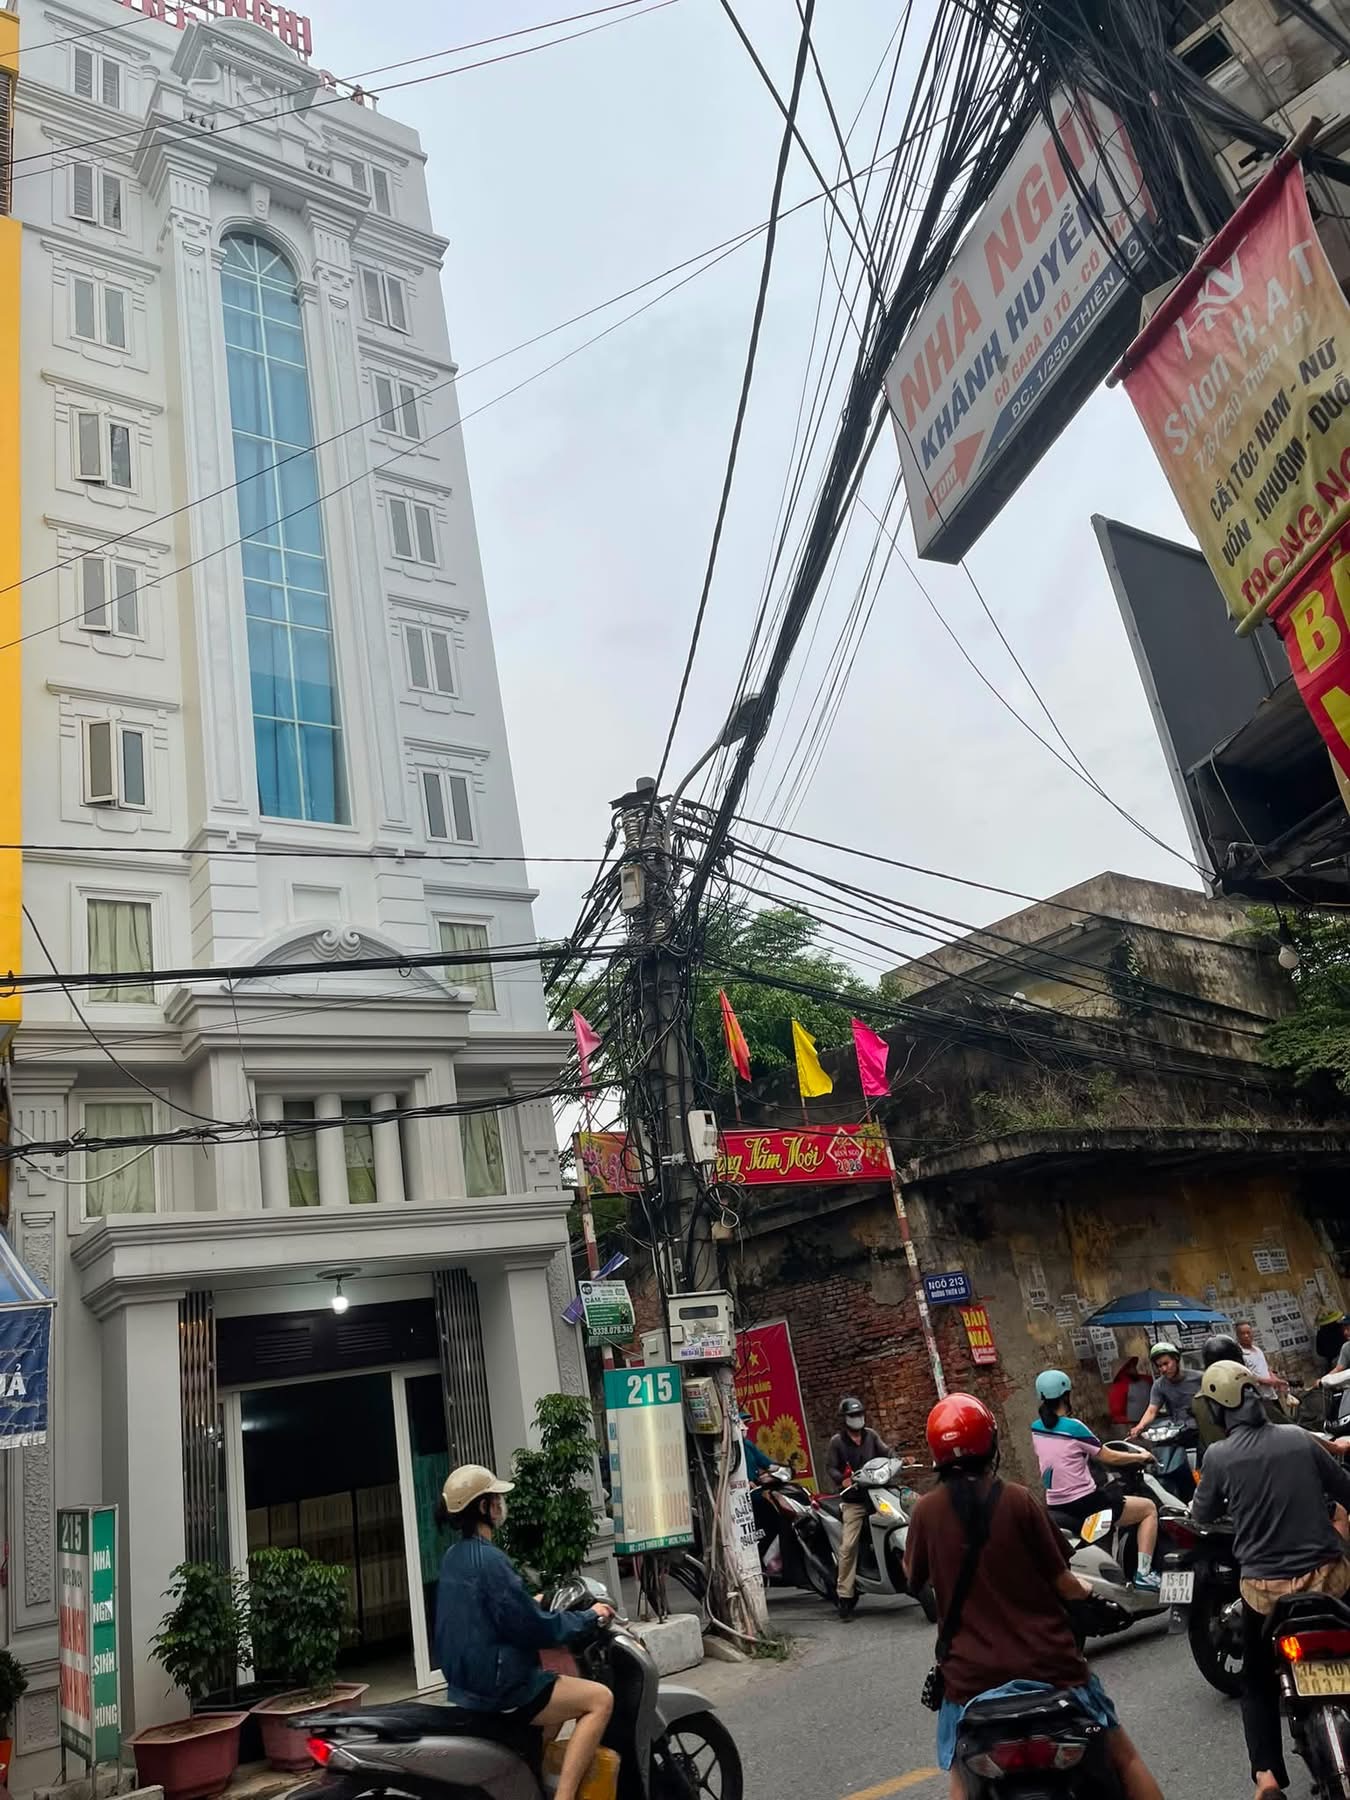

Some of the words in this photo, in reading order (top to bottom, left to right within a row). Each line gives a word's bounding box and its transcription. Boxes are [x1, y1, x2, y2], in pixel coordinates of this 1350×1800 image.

[1036, 335, 1070, 384] 1/250
[1071, 271, 1115, 334] THIÊN
[900, 275, 983, 433] NHÀ
[1012, 334, 1043, 383] GARA
[920, 328, 1003, 471] KHÁNH
[1164, 353, 1231, 455] Salon
[1230, 441, 1259, 489] TÓC
[1254, 387, 1291, 450] NAM
[1298, 336, 1337, 386] NỮ
[1222, 518, 1252, 567] UỐN
[1254, 435, 1308, 521] NHUỘM
[744, 1137, 782, 1171] Năm
[779, 1136, 825, 1175] Mới
[948, 1277, 964, 1287] 213
[962, 1308, 987, 1328] BÁN
[967, 1327, 993, 1347] NHÀ
[627, 1373, 672, 1405] 215
[61, 1513, 82, 1551] 215
[93, 1545, 111, 1572] NHÀ
[95, 1702, 118, 1729] HÙNG
